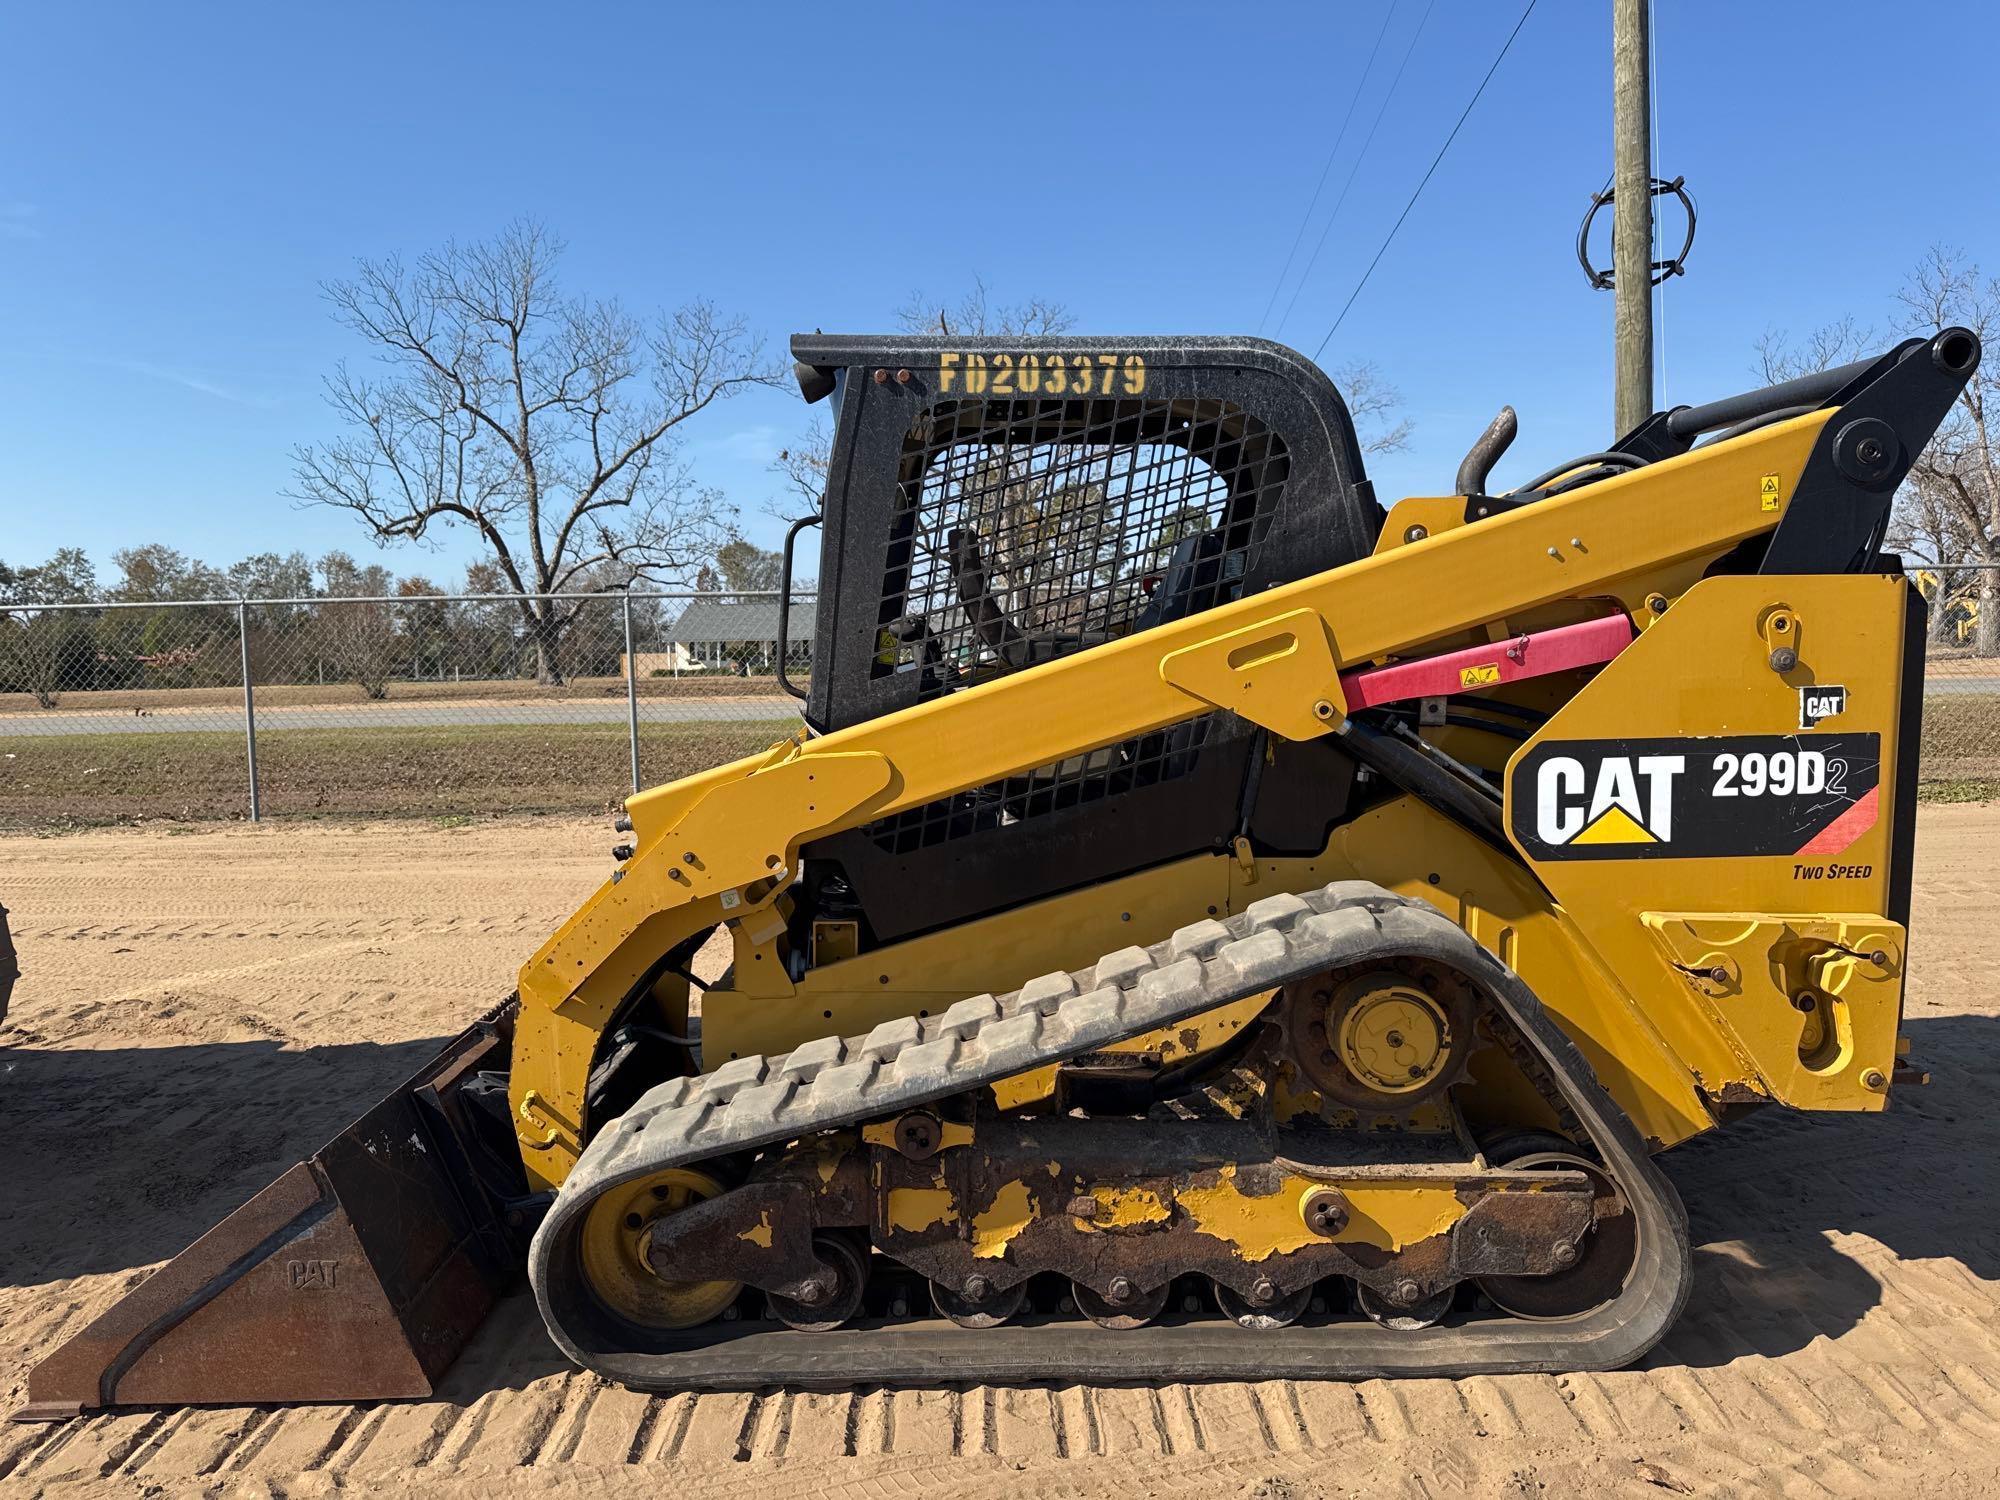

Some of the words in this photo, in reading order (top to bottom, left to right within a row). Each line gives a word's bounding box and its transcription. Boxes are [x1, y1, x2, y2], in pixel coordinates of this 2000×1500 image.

[940, 353, 1145, 395] FD203379
[1806, 696, 1840, 718] CAT
[1536, 755, 1686, 846] CAT
[287, 1259, 339, 1290] CAT
